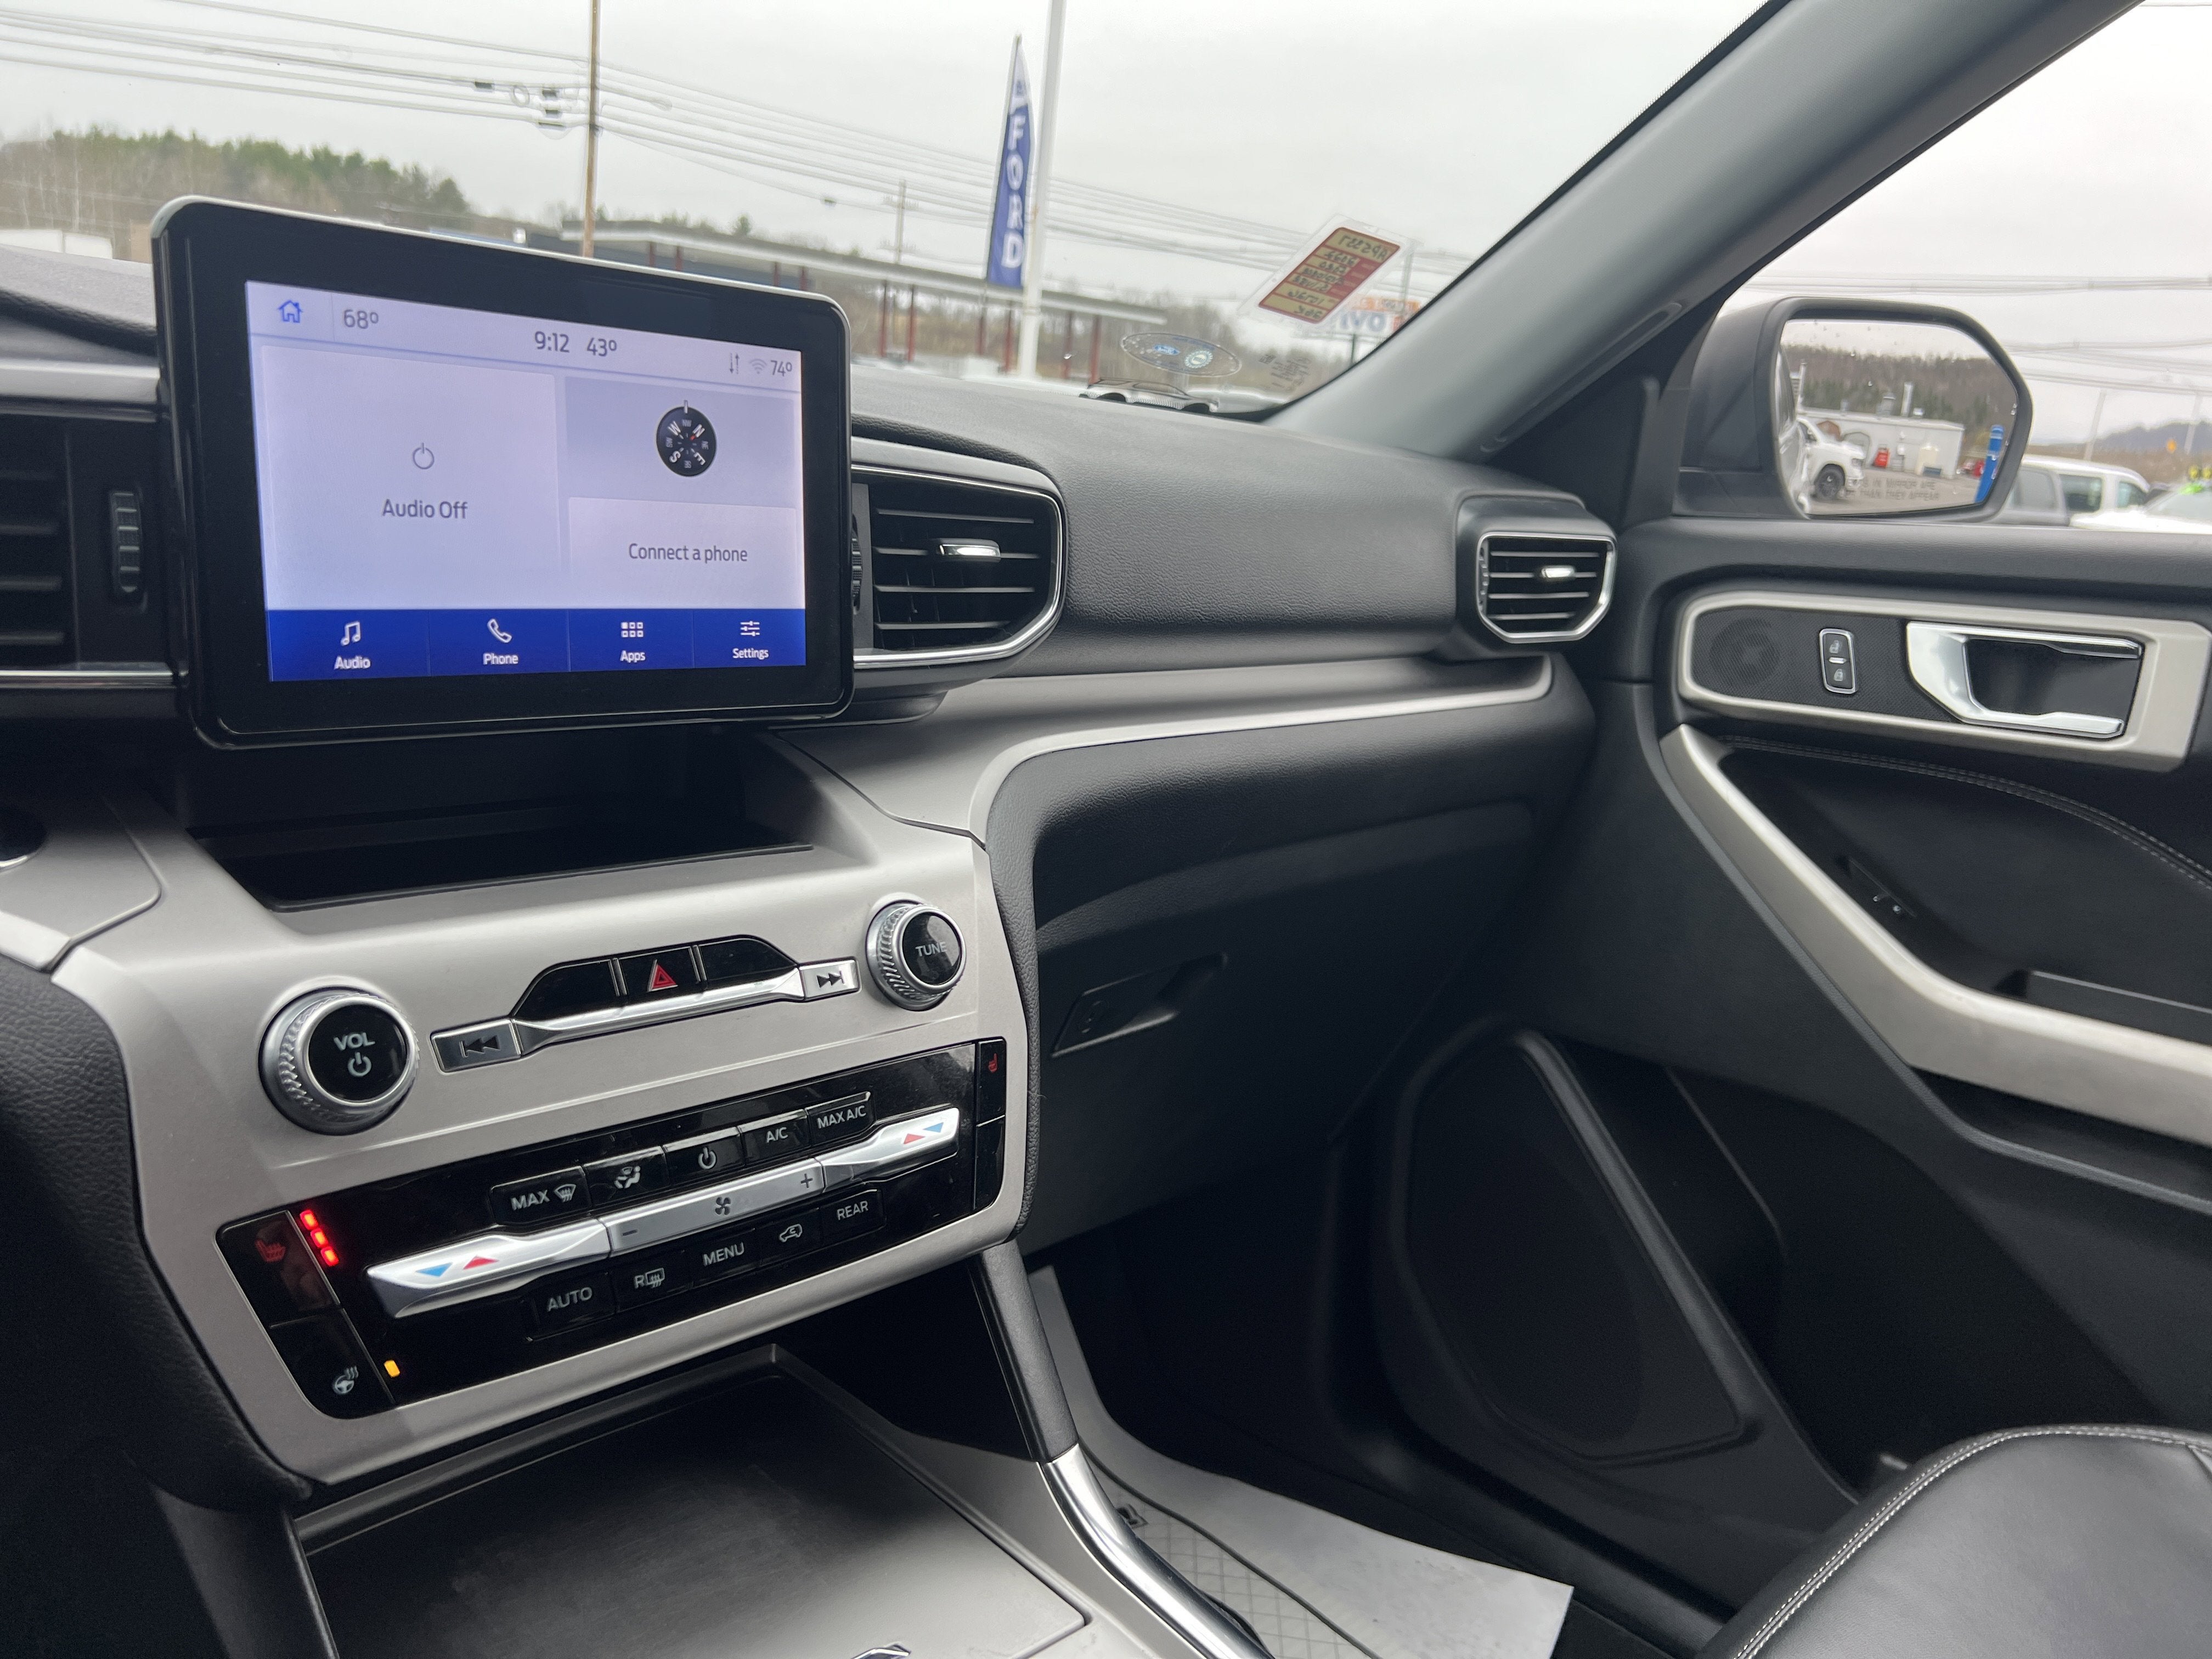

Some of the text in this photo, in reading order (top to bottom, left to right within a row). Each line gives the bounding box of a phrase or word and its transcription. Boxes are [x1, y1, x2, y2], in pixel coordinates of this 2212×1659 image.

[1002, 115, 1026, 268] FORD
[534, 331, 570, 353] 9:12
[692, 424, 705, 438] N
[669, 450, 681, 463] S
[693, 452, 706, 466] E
[382, 499, 468, 519] Audio Off
[628, 543, 748, 564] Connect a phone
[334, 655, 371, 670] Audio
[482, 652, 519, 666] Phone
[620, 650, 645, 664] Apps
[732, 647, 769, 661] Settings
[915, 941, 947, 957] TUNE
[334, 1032, 375, 1051] VOL
[816, 1104, 867, 1130] MAX A/C
[765, 1126, 788, 1143] A/C
[511, 1188, 549, 1211] MAX
[837, 1200, 868, 1221] REAR
[702, 1242, 746, 1267] MENU
[546, 1286, 594, 1312] AUTO
